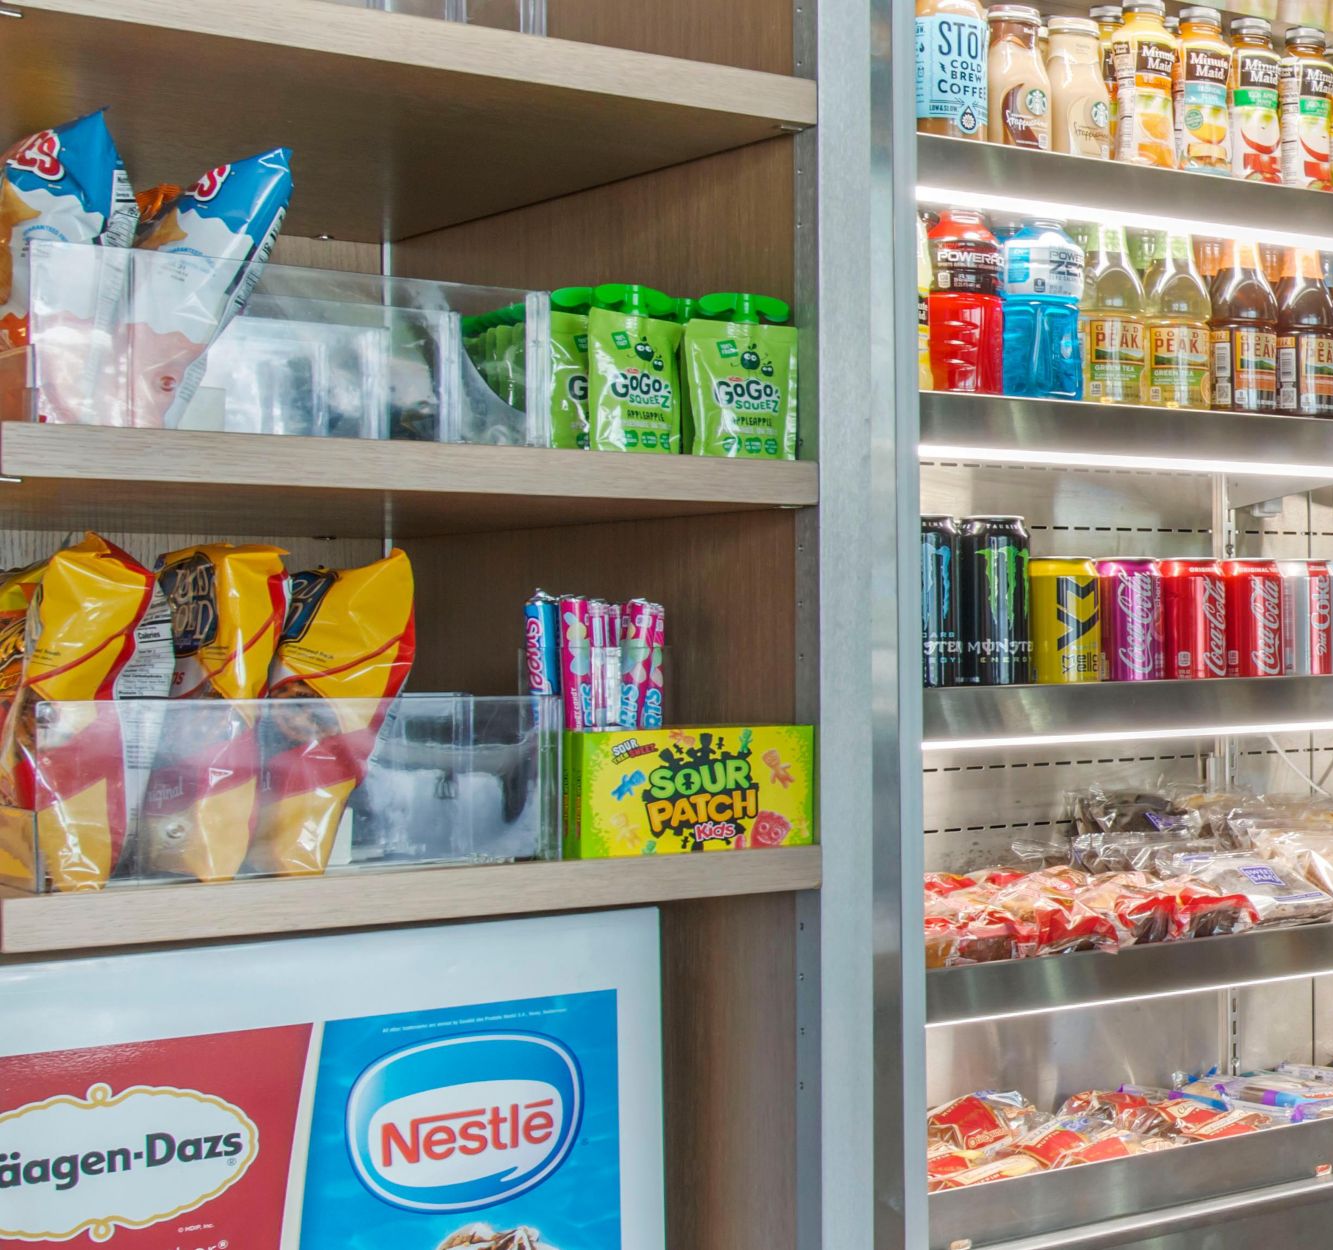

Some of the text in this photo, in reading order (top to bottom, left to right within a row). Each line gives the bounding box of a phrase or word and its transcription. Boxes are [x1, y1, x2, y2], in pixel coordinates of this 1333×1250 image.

[951, 60, 982, 73] COLD
[1147, 57, 1172, 71] Maid
[1190, 52, 1228, 70] Minute
[951, 71, 982, 82] BREW
[1195, 65, 1225, 80] Maid
[1250, 70, 1278, 86] Maid
[1095, 335, 1140, 349] PEAK
[1154, 337, 1199, 354] PEAK
[630, 393, 670, 408] SQUEEZ
[736, 400, 779, 413] SQUEEZ
[1310, 575, 1330, 630] Coke
[1118, 569, 1152, 674] Coca-Cola
[1202, 576, 1227, 676] Coca-Cola
[1251, 575, 1280, 675] Coca-Cola
[611, 739, 638, 756] SOUR
[650, 759, 750, 798] SOUR
[647, 789, 758, 833] PATCH
[695, 822, 736, 842] Kids
[379, 1098, 554, 1168] Nestlé
[0, 1132, 243, 1191] äagen-Dazs
